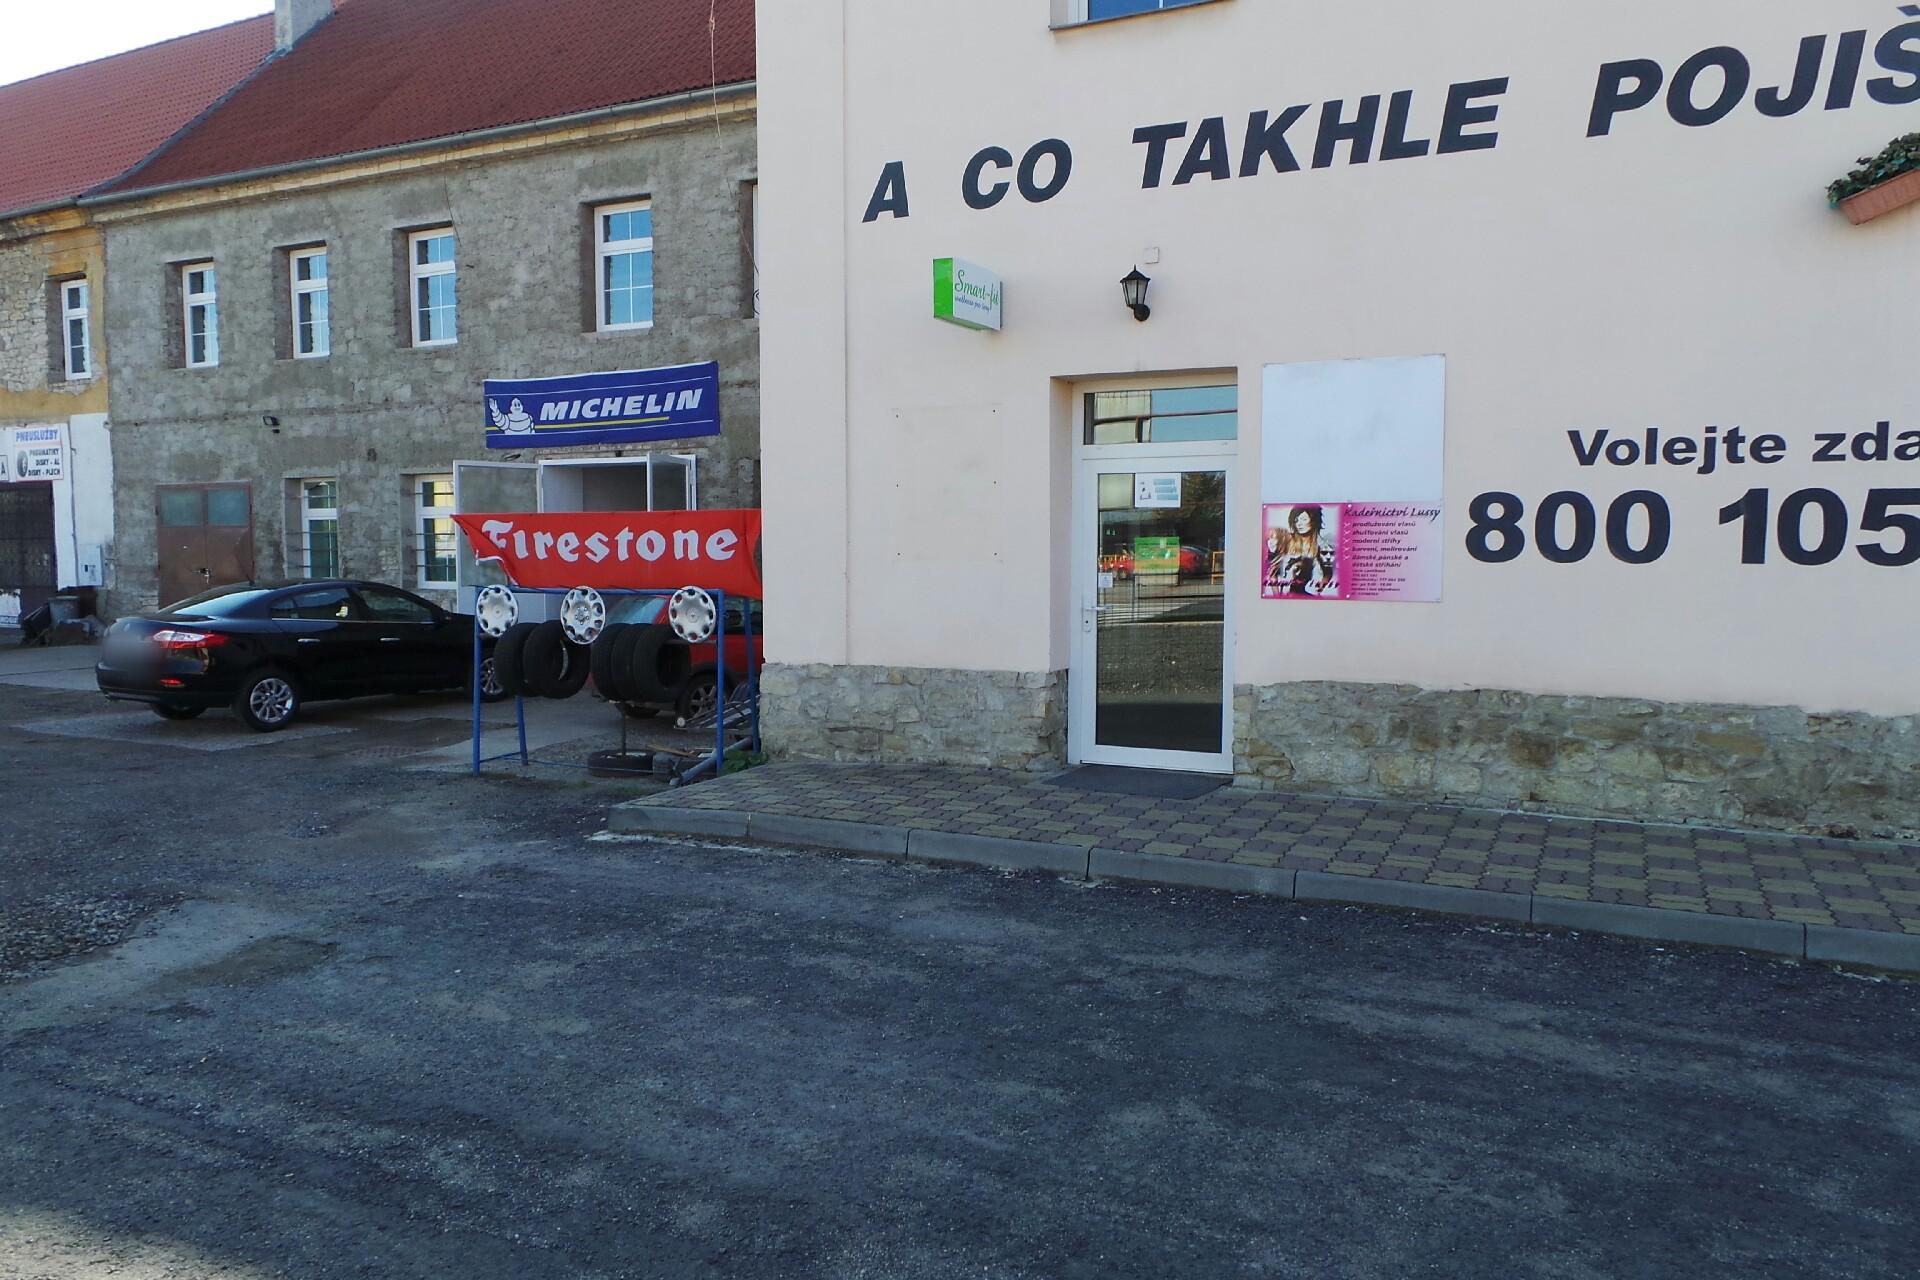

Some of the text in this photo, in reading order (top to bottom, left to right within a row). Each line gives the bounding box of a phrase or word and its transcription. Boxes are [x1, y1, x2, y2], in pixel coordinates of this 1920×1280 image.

[862, 4, 1920, 222] A CO TAKHLE POJIŠ
[539, 388, 703, 421] MICHELIN
[1567, 421, 1920, 475] Volejte zda
[481, 519, 738, 563] Firestone
[1465, 487, 1920, 567] 800 105
